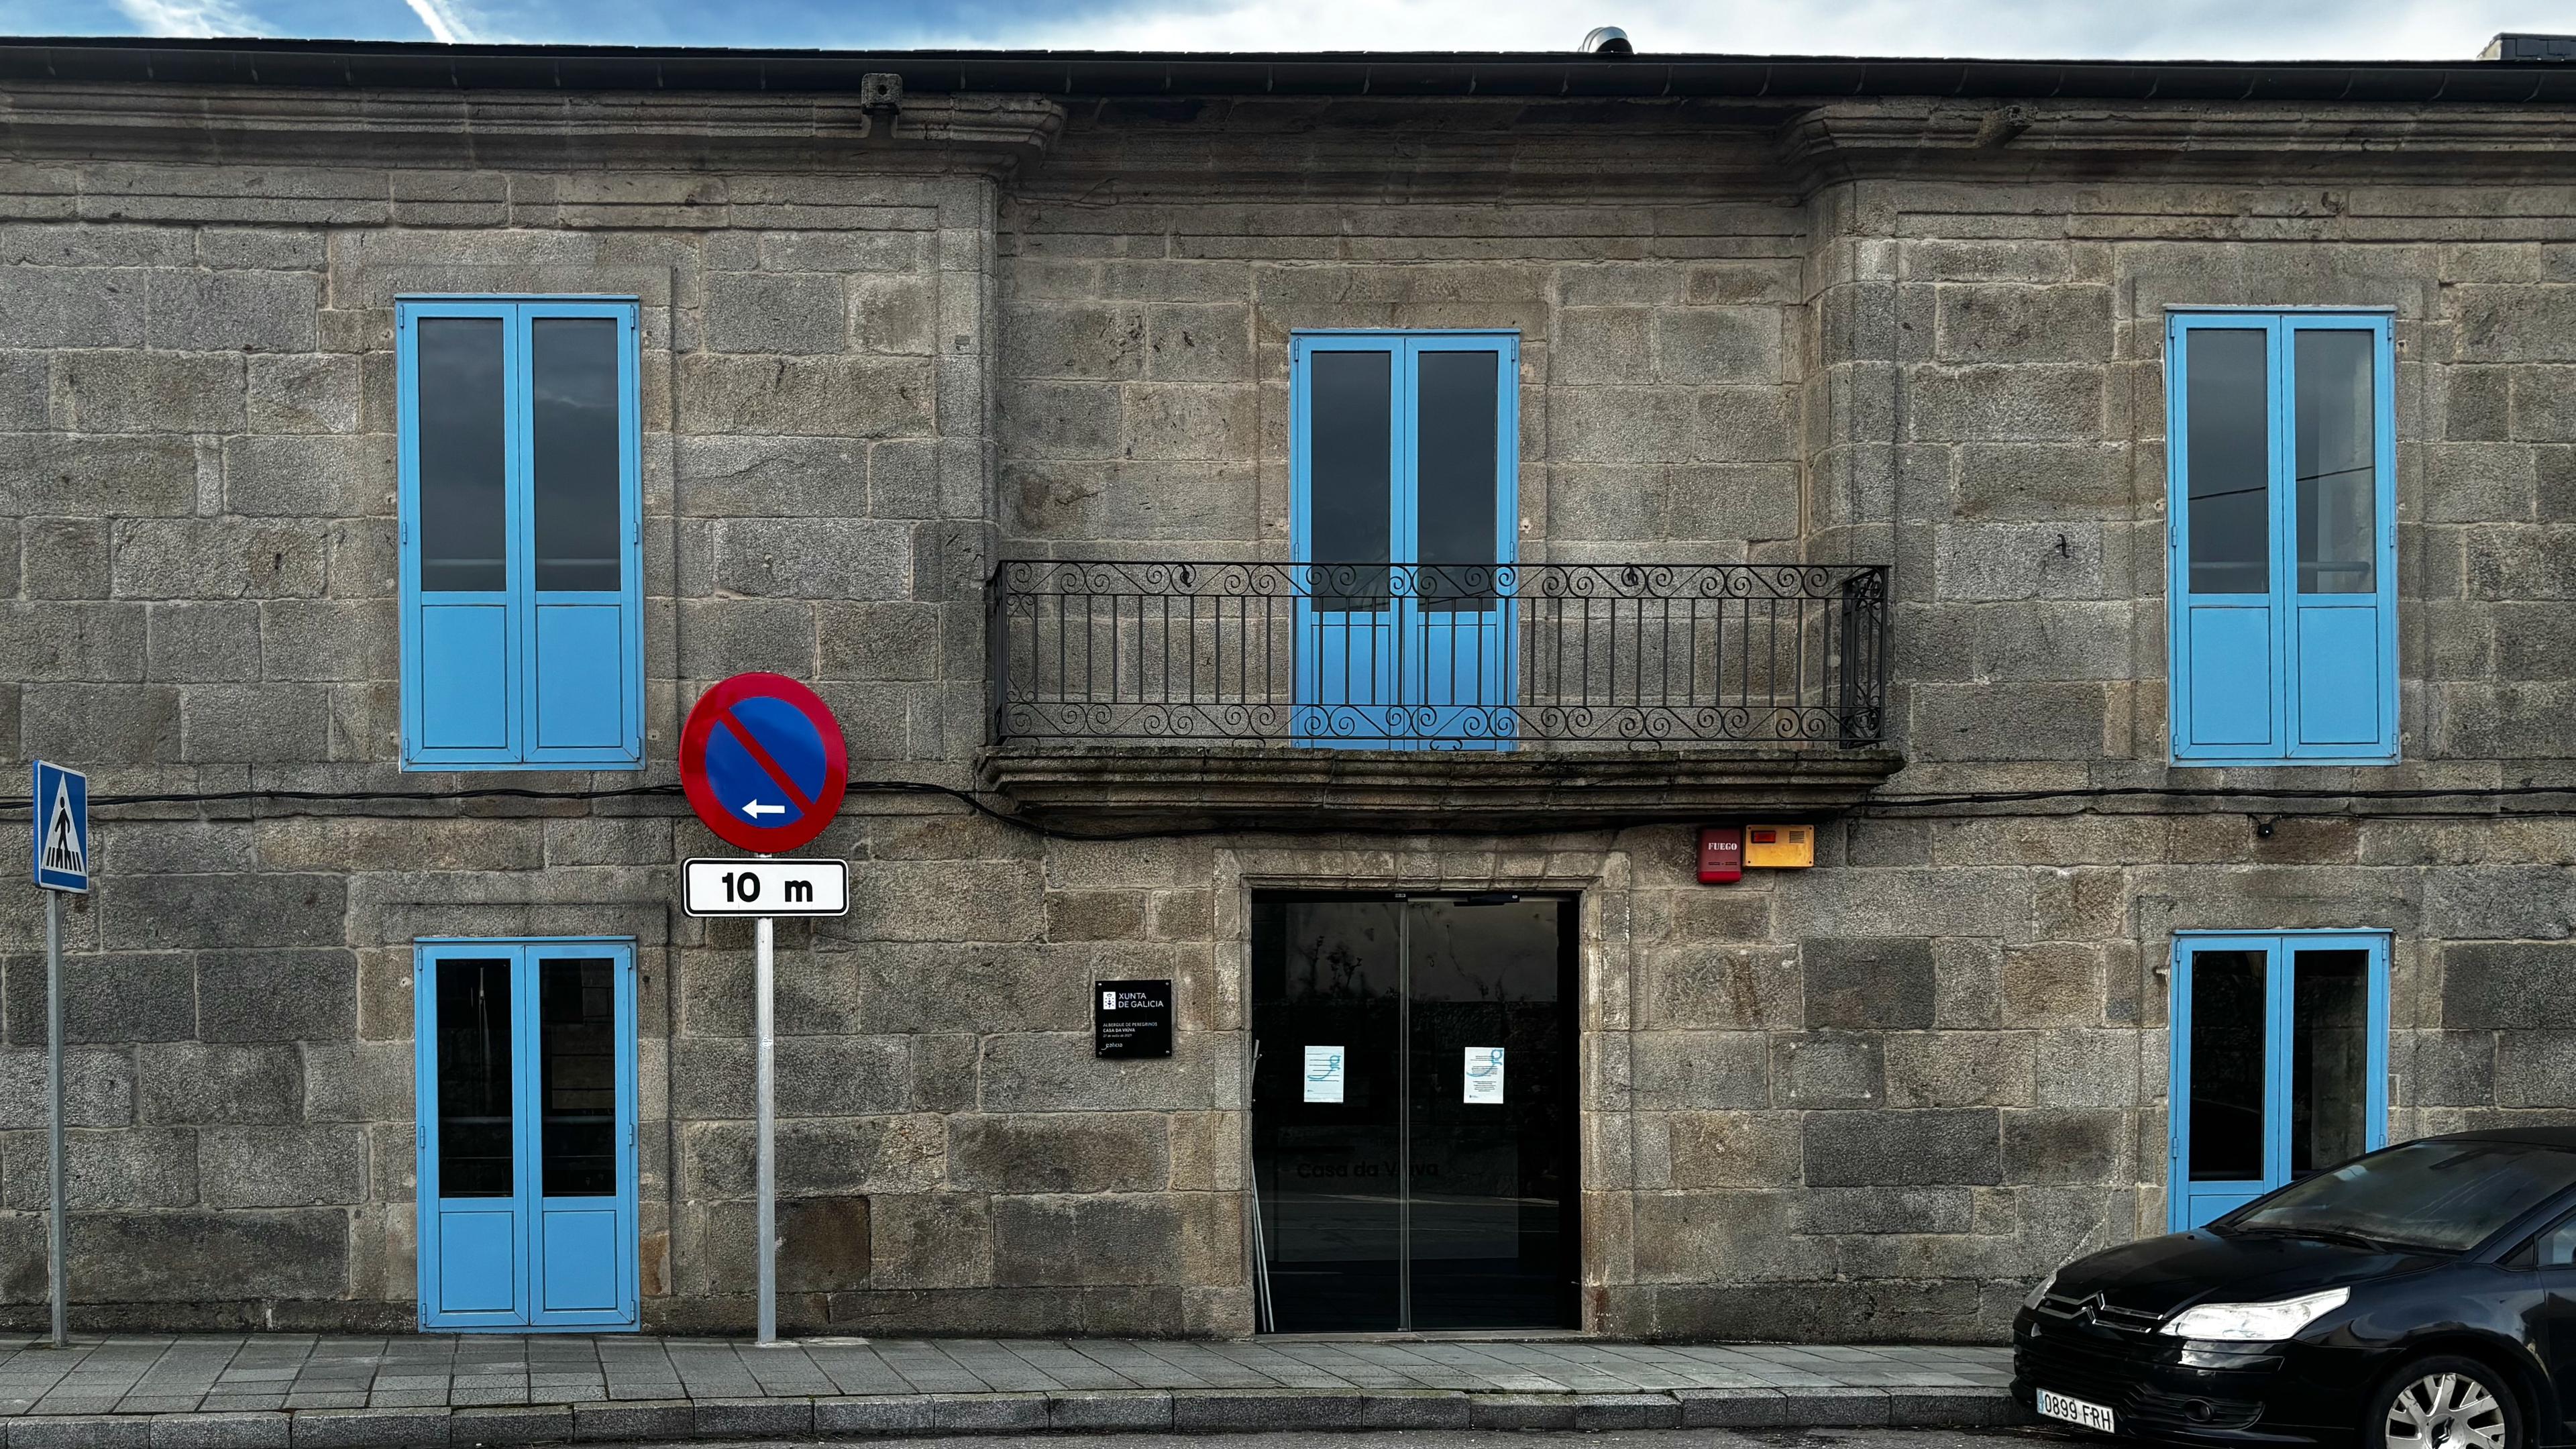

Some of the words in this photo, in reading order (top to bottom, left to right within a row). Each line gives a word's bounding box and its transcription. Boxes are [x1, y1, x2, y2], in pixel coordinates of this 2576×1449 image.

[722, 871, 761, 902] 10
[785, 879, 813, 902] m
[1297, 1163, 1348, 1178] Casa
[1354, 1160, 1379, 1177] da
[2045, 1394, 2078, 1420] 0899
[2082, 1405, 2110, 1430] FRH
